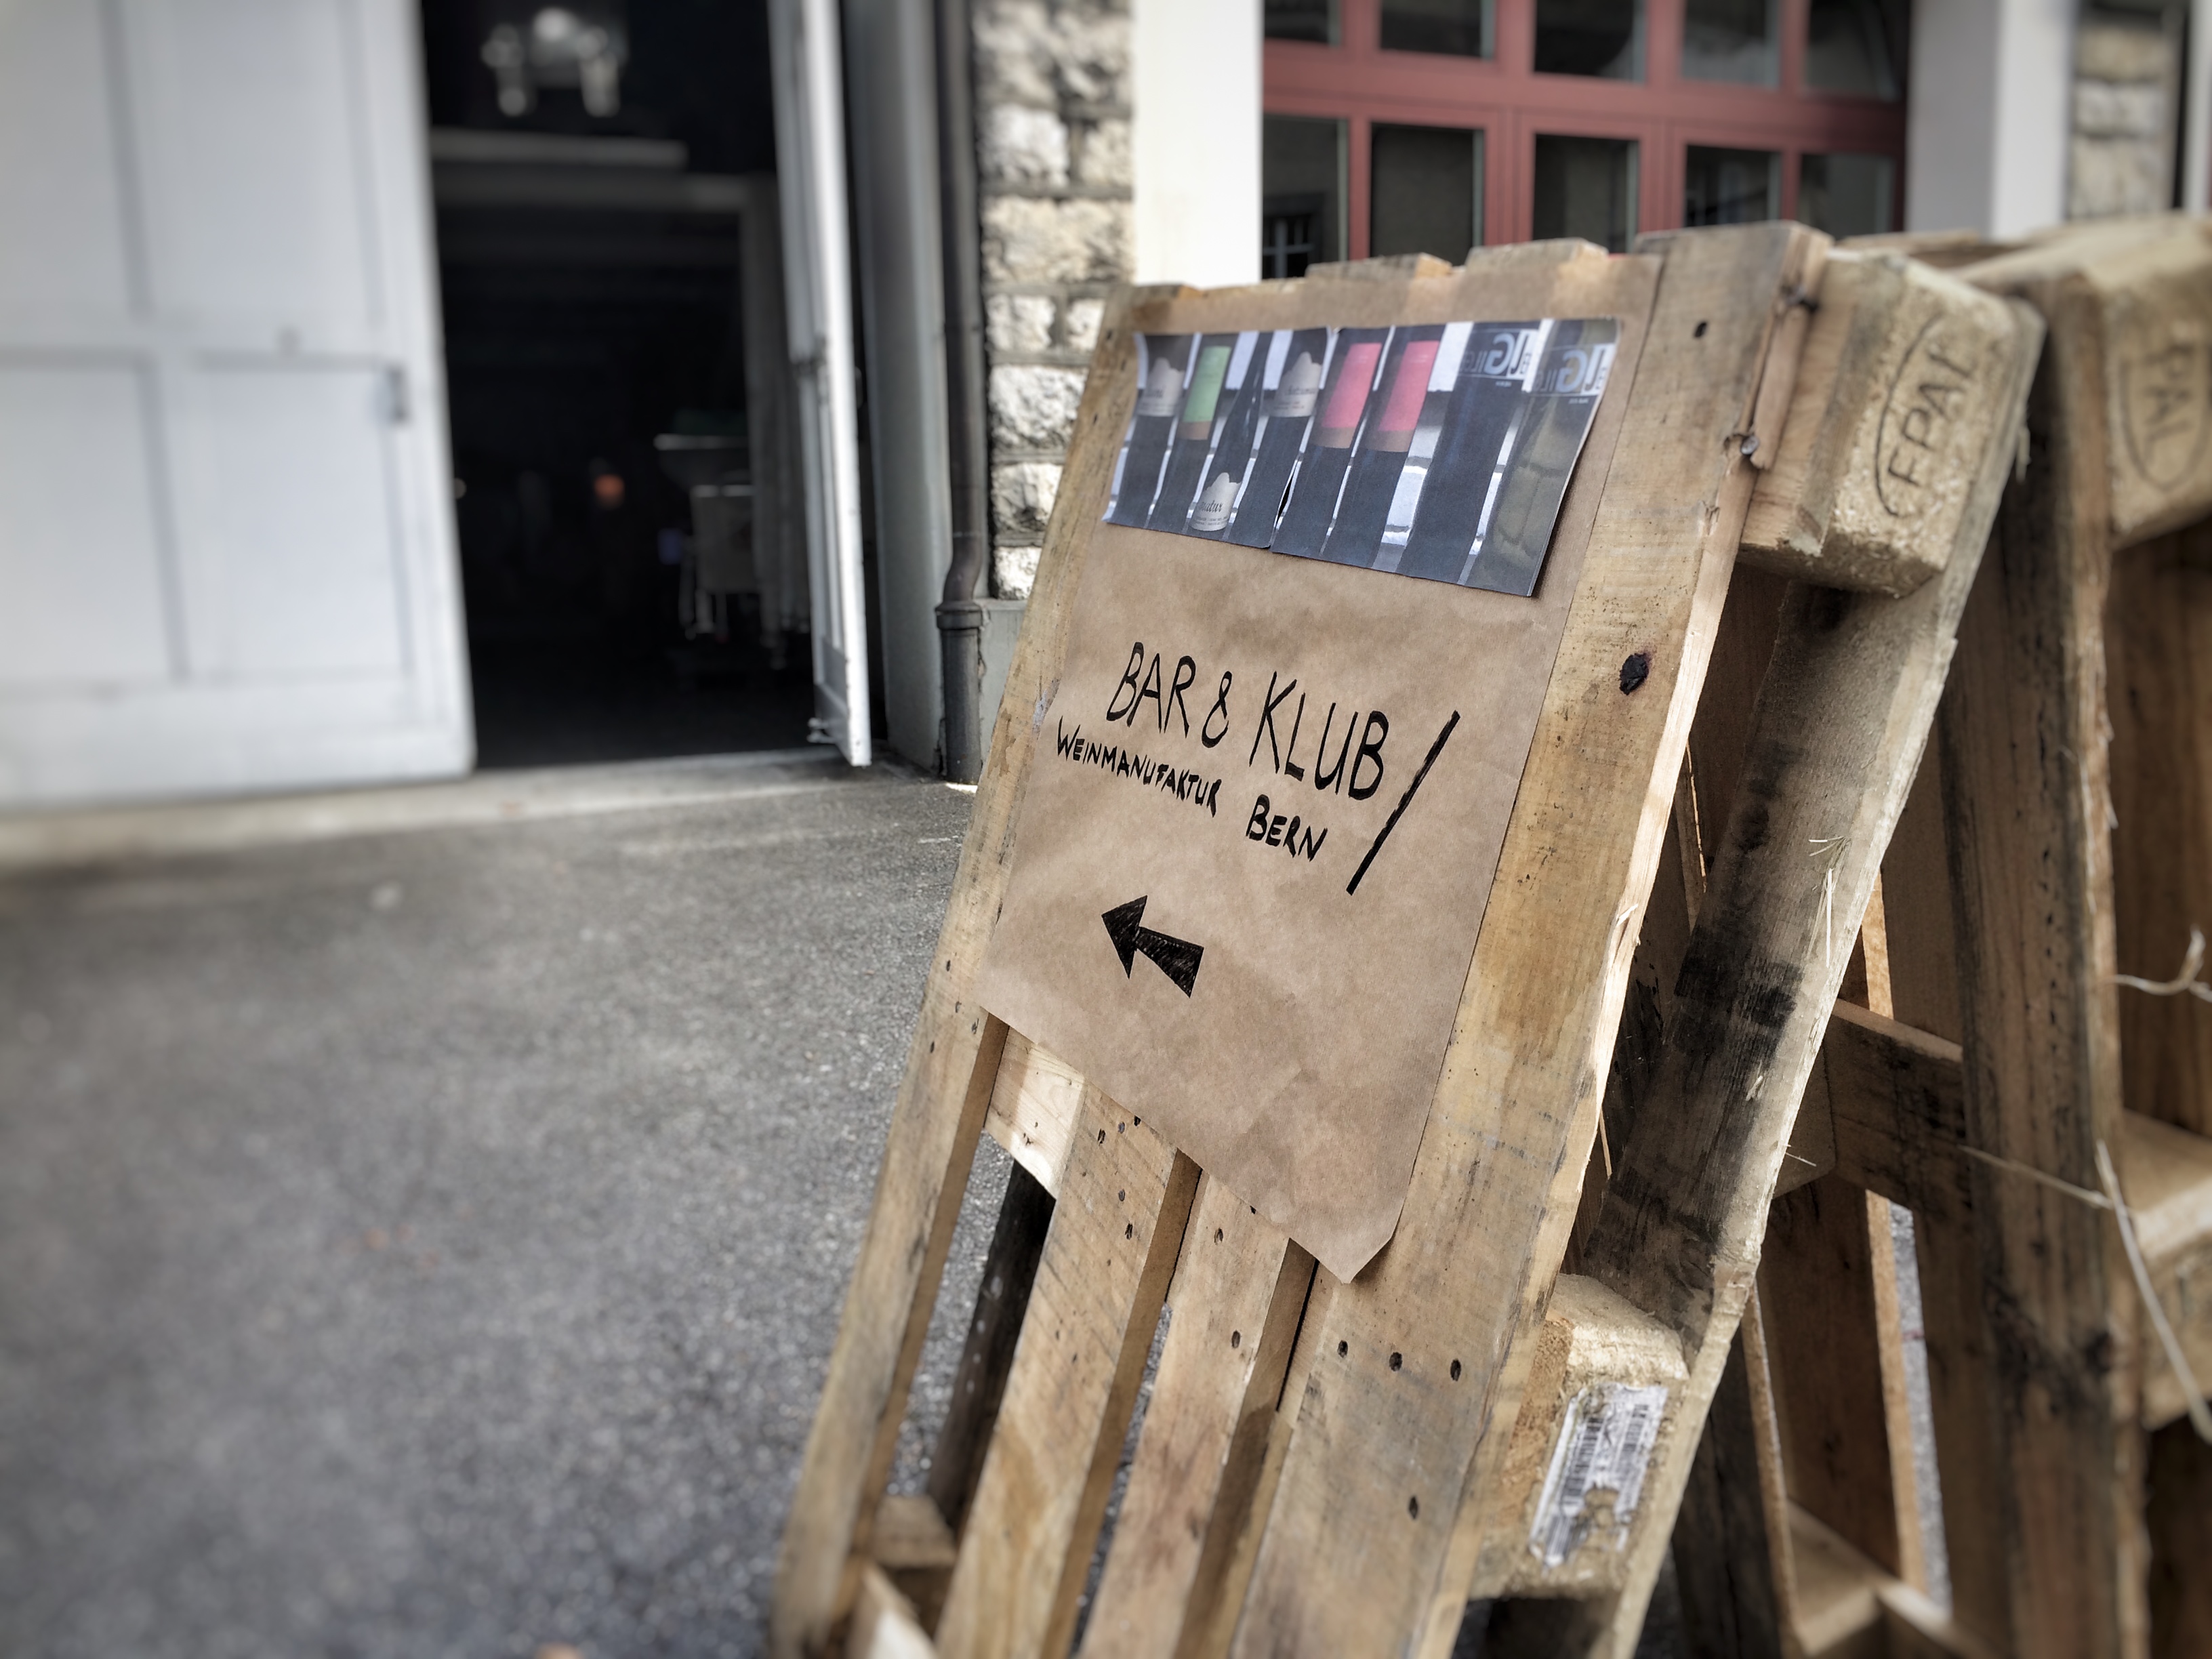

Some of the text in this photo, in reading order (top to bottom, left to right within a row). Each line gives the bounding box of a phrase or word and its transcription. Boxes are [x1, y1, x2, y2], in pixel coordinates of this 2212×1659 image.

[1057, 716, 1328, 862] WEINMANUFAKTUR BERN
[1106, 642, 1196, 739] BAR
[1202, 670, 1233, 749] &
[1249, 671, 1389, 801] KLUB
